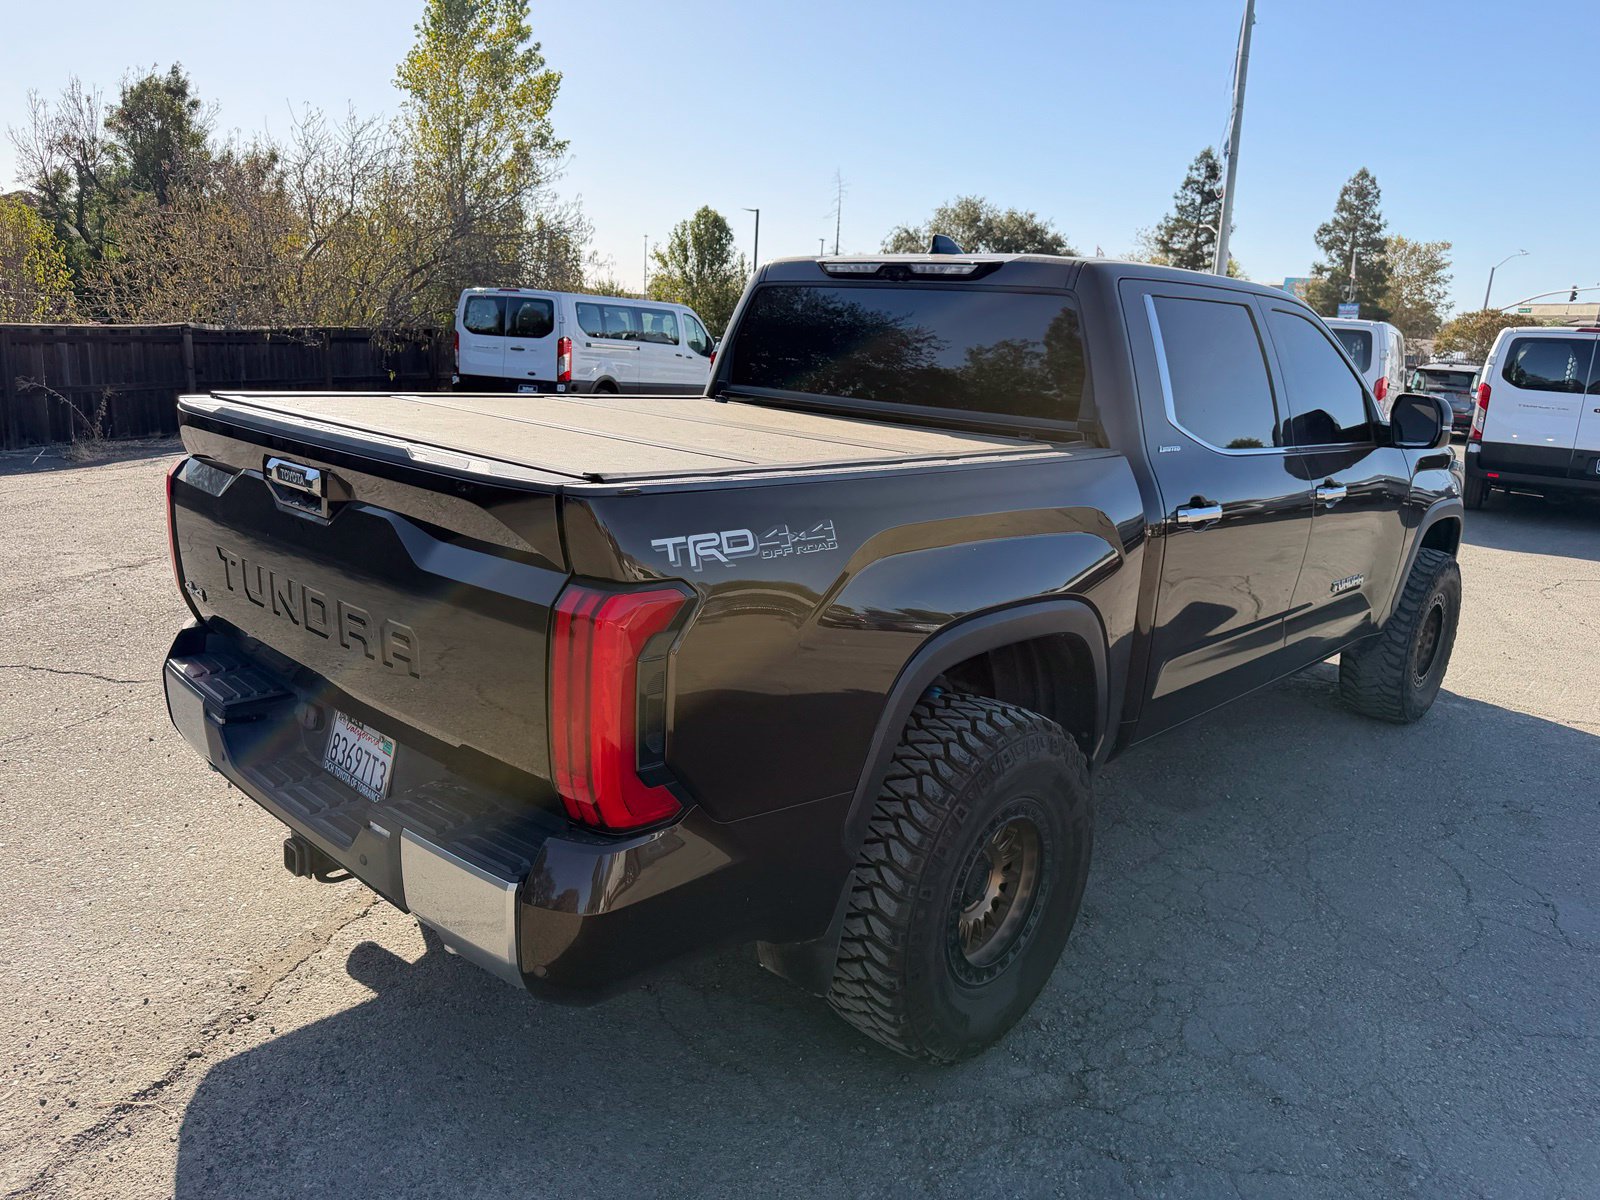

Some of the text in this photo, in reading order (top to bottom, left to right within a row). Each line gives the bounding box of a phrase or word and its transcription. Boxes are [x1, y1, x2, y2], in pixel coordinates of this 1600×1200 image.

[280, 468, 305, 486] TOYOTA
[651, 528, 760, 572] TRD
[762, 541, 839, 560] OFF ROAD
[1331, 574, 1364, 593] TUNDRA
[216, 545, 421, 680] TUNDRA
[346, 721, 380, 746] California
[330, 732, 387, 792] 83697T3
[334, 766, 351, 785] TOYOTA
[357, 782, 381, 803] TORRANCE
